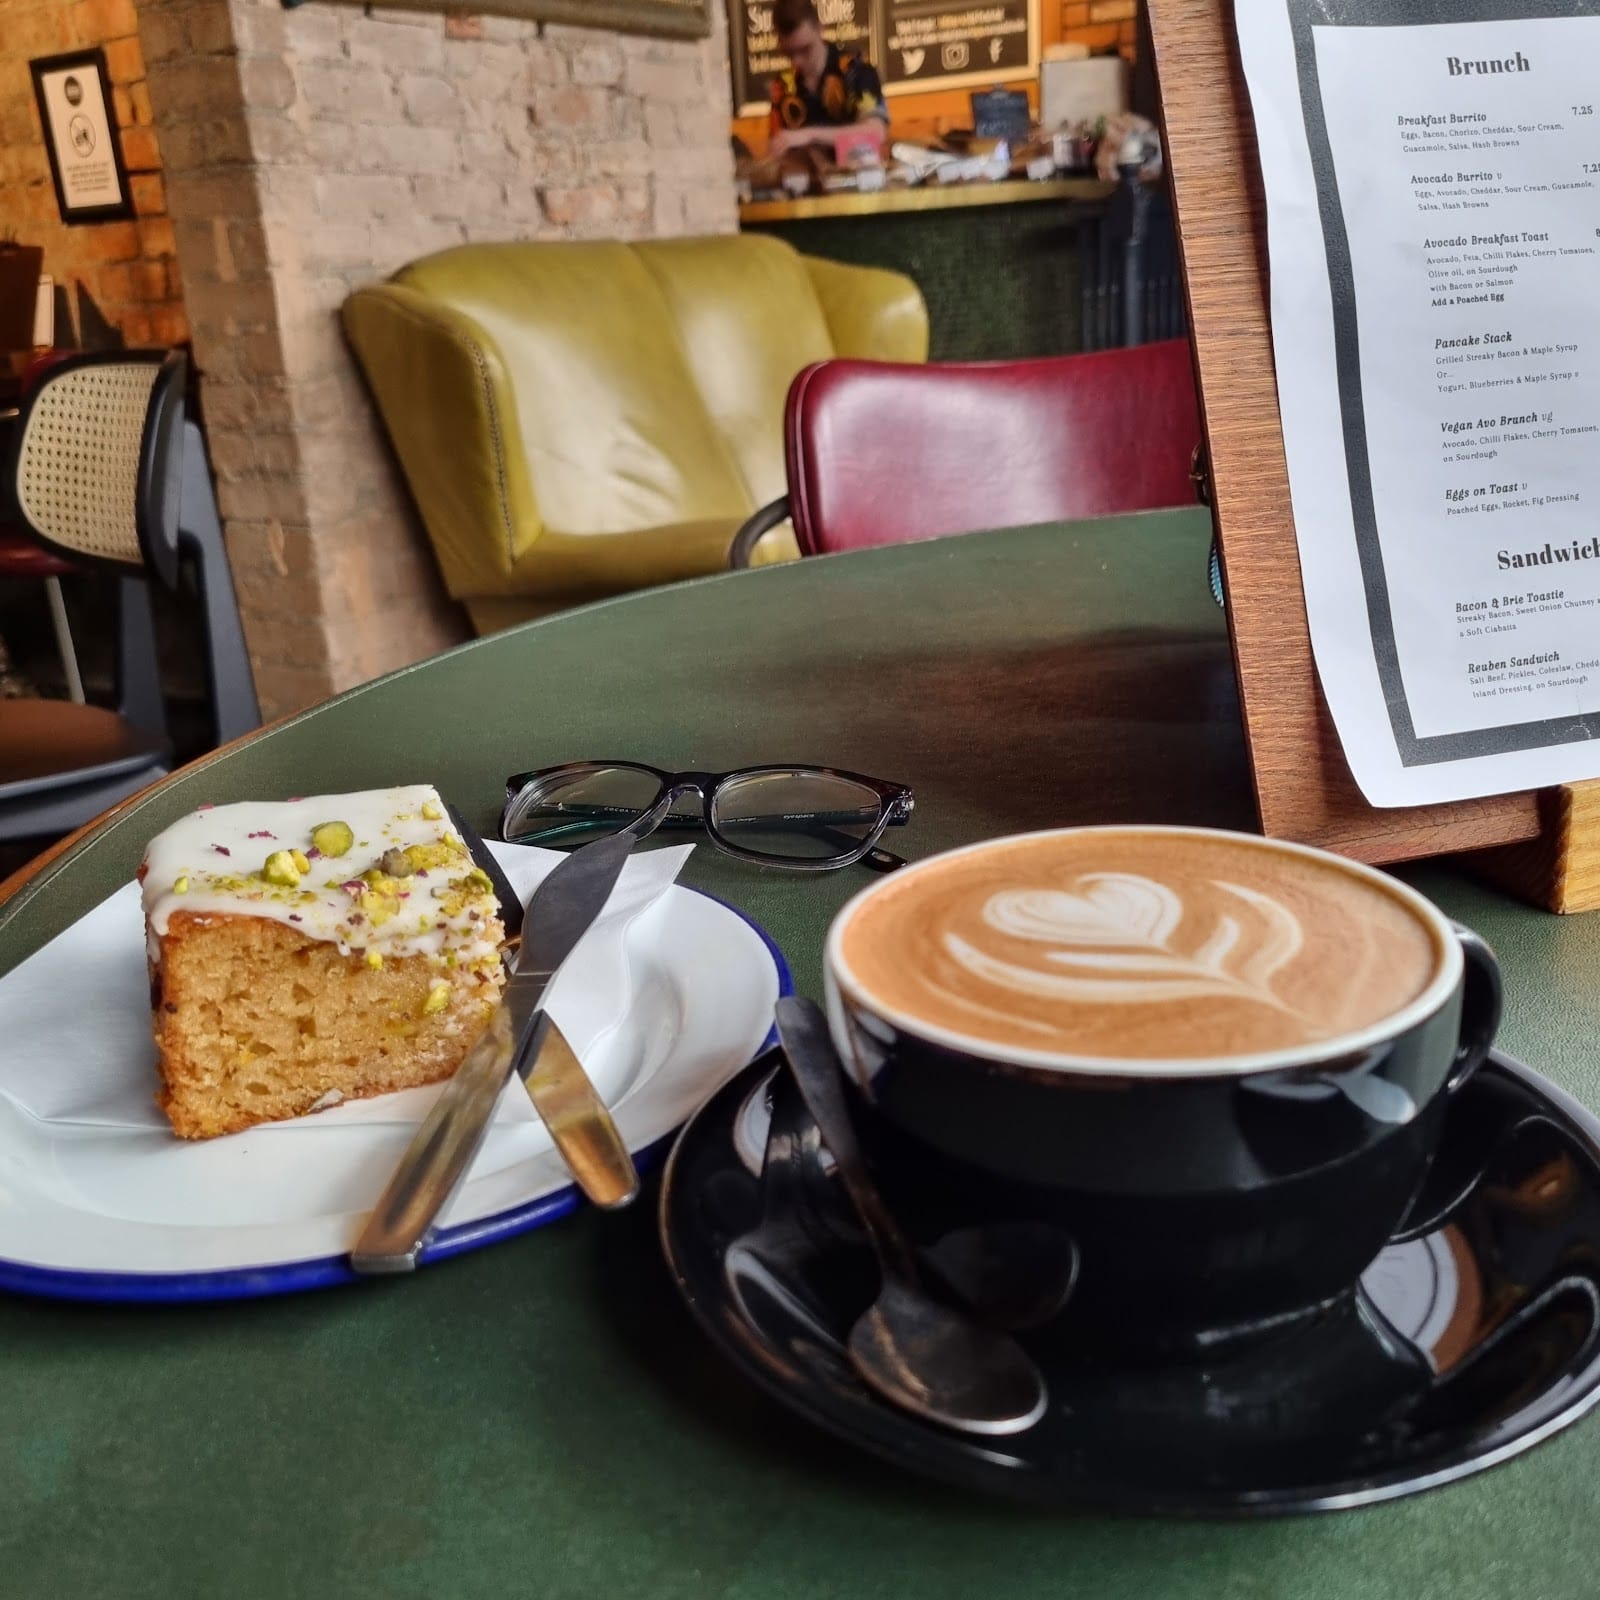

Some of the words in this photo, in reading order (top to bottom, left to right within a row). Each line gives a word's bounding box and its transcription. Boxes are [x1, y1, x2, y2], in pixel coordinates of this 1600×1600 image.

[1446, 51, 1530, 76] Brunch
[1571, 105, 1593, 116] 7.25
[1397, 114, 1446, 127] Breakfast
[1450, 112, 1487, 124] Burrito
[1401, 131, 1420, 140] Eggs,
[1423, 130, 1447, 138] Bacon,
[1482, 126, 1516, 135] Cheddar,
[1518, 124, 1536, 132] Sour
[1403, 144, 1447, 153] Guacamole,
[1472, 141, 1491, 149] Hash
[1493, 140, 1520, 148] Browns
[1410, 173, 1453, 184] Avocado
[1457, 171, 1493, 182] Burrito
[1414, 190, 1435, 199] Eggs,
[1437, 188, 1469, 197] Avocado,
[1470, 187, 1504, 195] Cheddar,
[1504, 185, 1522, 193] Sour
[1523, 184, 1551, 192] Cream,
[1442, 202, 1461, 210] Hash
[1462, 201, 1489, 209] Browns
[1423, 236, 1468, 249] Avocado
[1471, 233, 1519, 246] Breakfast
[1521, 232, 1549, 242] Toast
[1426, 256, 1461, 265] Avocado,
[1482, 252, 1504, 260] Chilli
[1505, 250, 1531, 259] Flakes,
[1532, 248, 1557, 257] Cherry
[1428, 270, 1449, 279] Olive
[1466, 268, 1476, 276] on
[1478, 264, 1518, 274] Sourdough
[1430, 283, 1447, 292] with
[1449, 282, 1473, 291] Bacon
[1485, 279, 1514, 287] Salmon
[1431, 298, 1447, 307] Add
[1456, 294, 1489, 304] Poached
[1490, 293, 1505, 303] Egg
[1435, 335, 1480, 349] Pancake
[1483, 331, 1512, 344] Stack
[1436, 355, 1464, 365] Grilled
[1466, 352, 1495, 361] Streaky
[1497, 350, 1520, 359] Bacon
[1530, 346, 1553, 355] Maple
[1555, 344, 1578, 353] Syrup
[1438, 383, 1468, 393] Yogurt,
[1469, 378, 1514, 389] Blueberries
[1516, 376, 1522, 384] &
[1524, 374, 1547, 383] Maple
[1549, 372, 1572, 381] Syrup
[1441, 421, 1473, 434] Vegan
[1476, 418, 1496, 429] Avo
[1499, 412, 1538, 426] Brunch
[1442, 438, 1477, 449] Avocado,
[1479, 435, 1501, 444] Chilli
[1503, 433, 1530, 442] Flakes,
[1532, 430, 1558, 439] Cherry
[1560, 425, 1599, 435] Tomatoes,
[1456, 450, 1498, 461] Sourdough
[1445, 489, 1470, 502] Eggs
[1473, 487, 1486, 496] on
[1489, 483, 1518, 494] Toast
[1447, 504, 1479, 515] Poached
[1481, 503, 1501, 512] Eggs,
[1503, 499, 1530, 508] Rocket,
[1532, 497, 1544, 506] Fig
[1546, 493, 1580, 503] Dressing
[1455, 600, 1488, 613] Bacon
[1491, 598, 1499, 608] &
[1502, 595, 1524, 607] Brie
[1526, 590, 1565, 603] Toastie
[1456, 612, 1486, 624] Streaky
[1488, 610, 1514, 619] Bacon,
[1515, 607, 1537, 616] Sweet
[1539, 603, 1562, 612] Onion
[1564, 599, 1595, 609] Chutney
[1466, 627, 1483, 637] Soft
[1485, 623, 1518, 634] Ciabatta
[1468, 660, 1507, 674] Reuben
[1510, 651, 1560, 668] Sandwich
[1469, 677, 1485, 685] Salt
[1487, 674, 1506, 683] Beef,
[1508, 670, 1537, 680] Pickles,
[1538, 664, 1574, 676] Coleslaw,
[1473, 689, 1497, 698] Island
[1536, 681, 1546, 689] on
[1547, 674, 1588, 687] Sourdough
